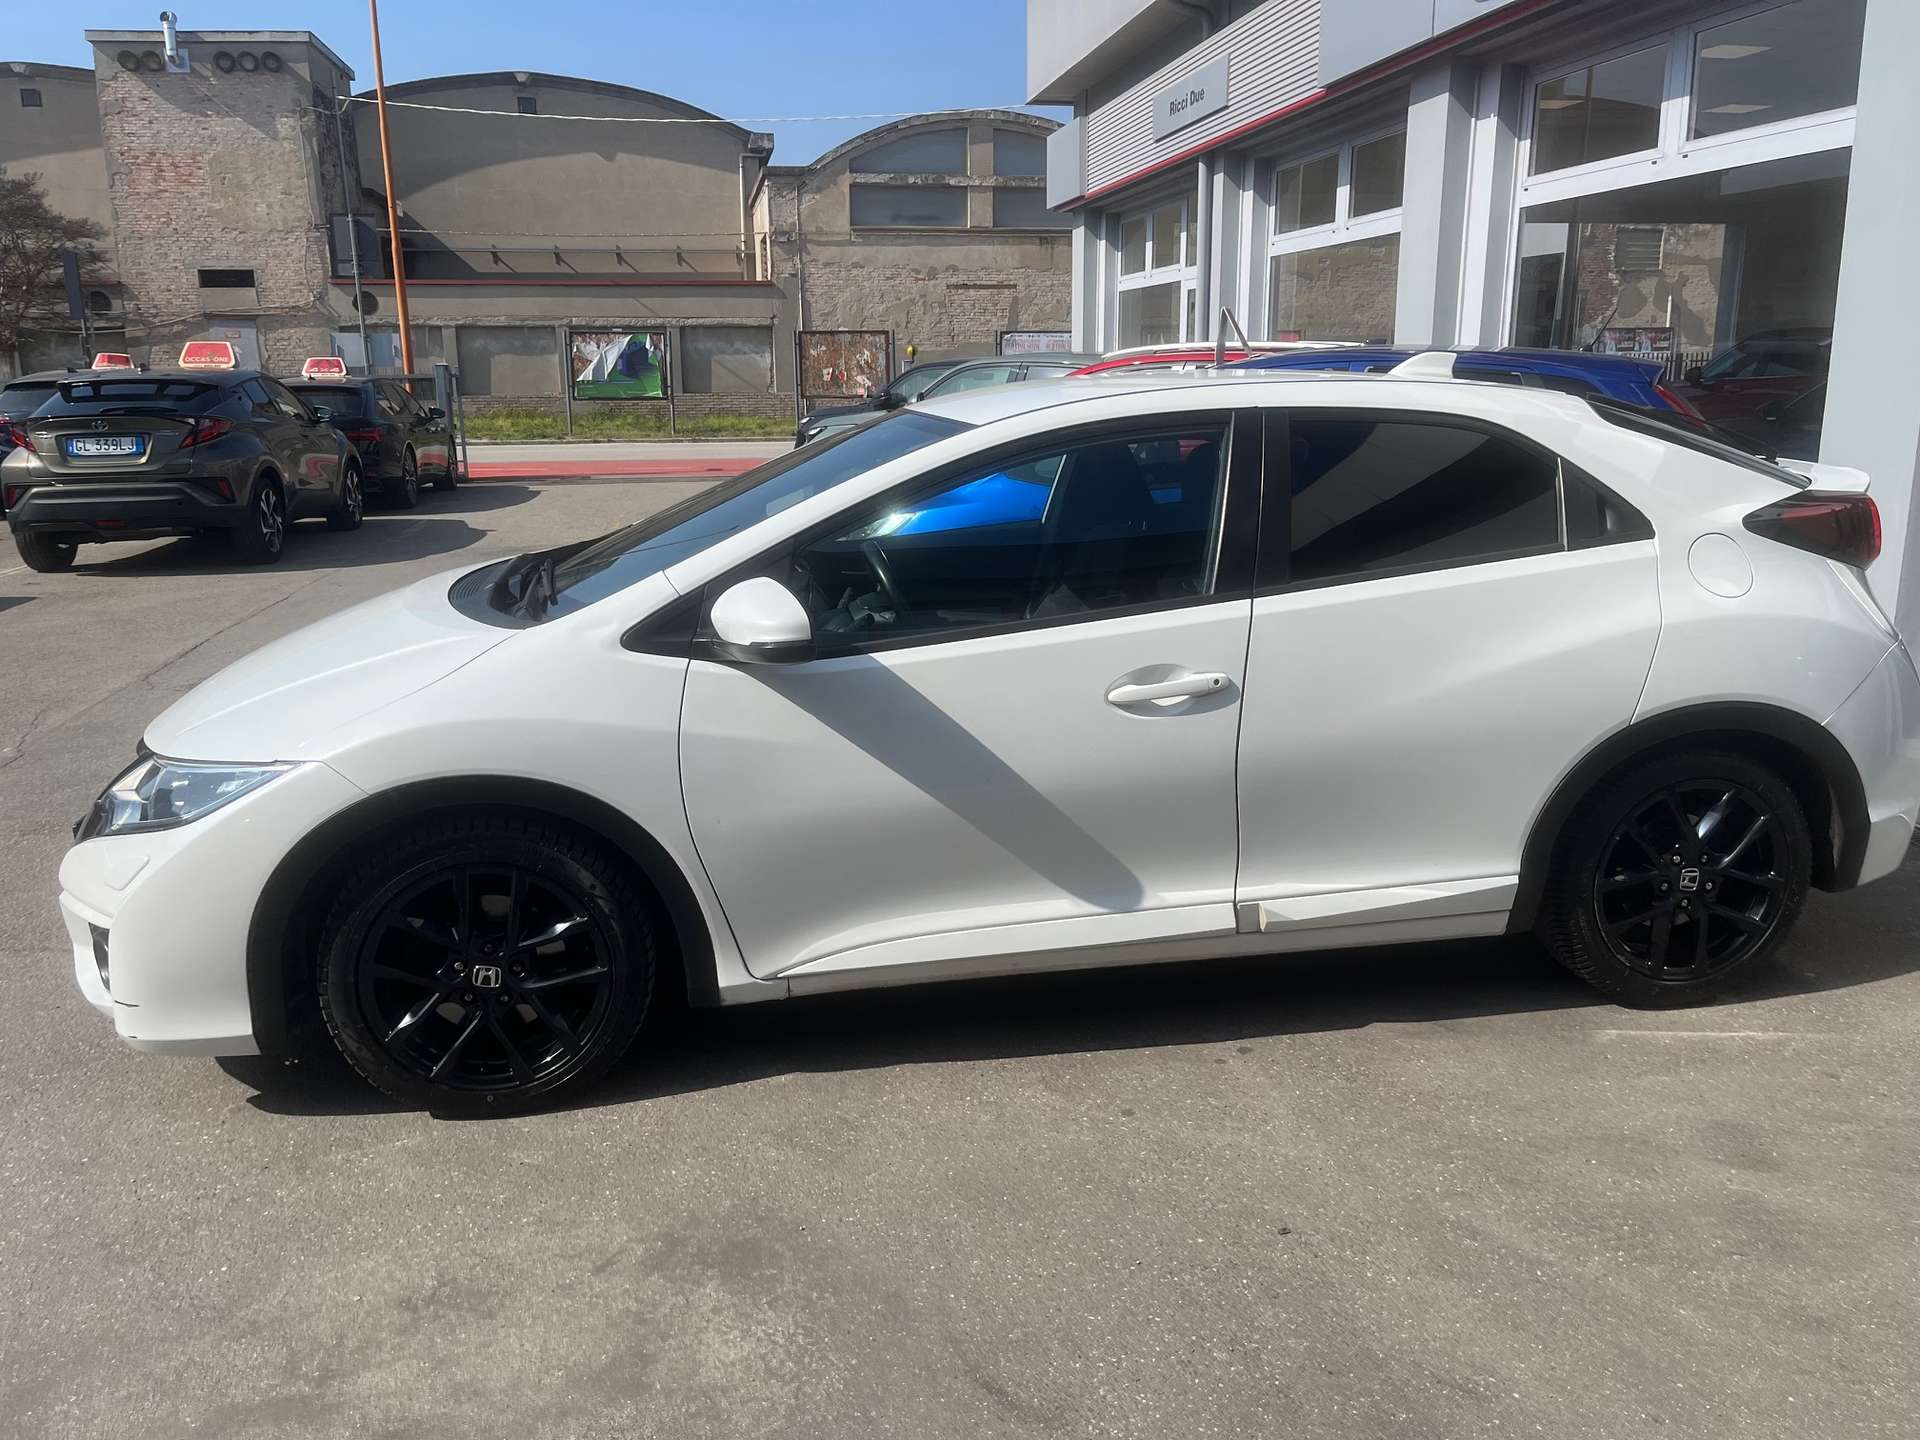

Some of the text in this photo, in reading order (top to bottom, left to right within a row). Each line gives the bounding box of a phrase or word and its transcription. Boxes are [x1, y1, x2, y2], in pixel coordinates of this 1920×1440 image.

[1169, 88, 1205, 116] Ricci Due
[75, 439, 135, 452] GL 339LJ
